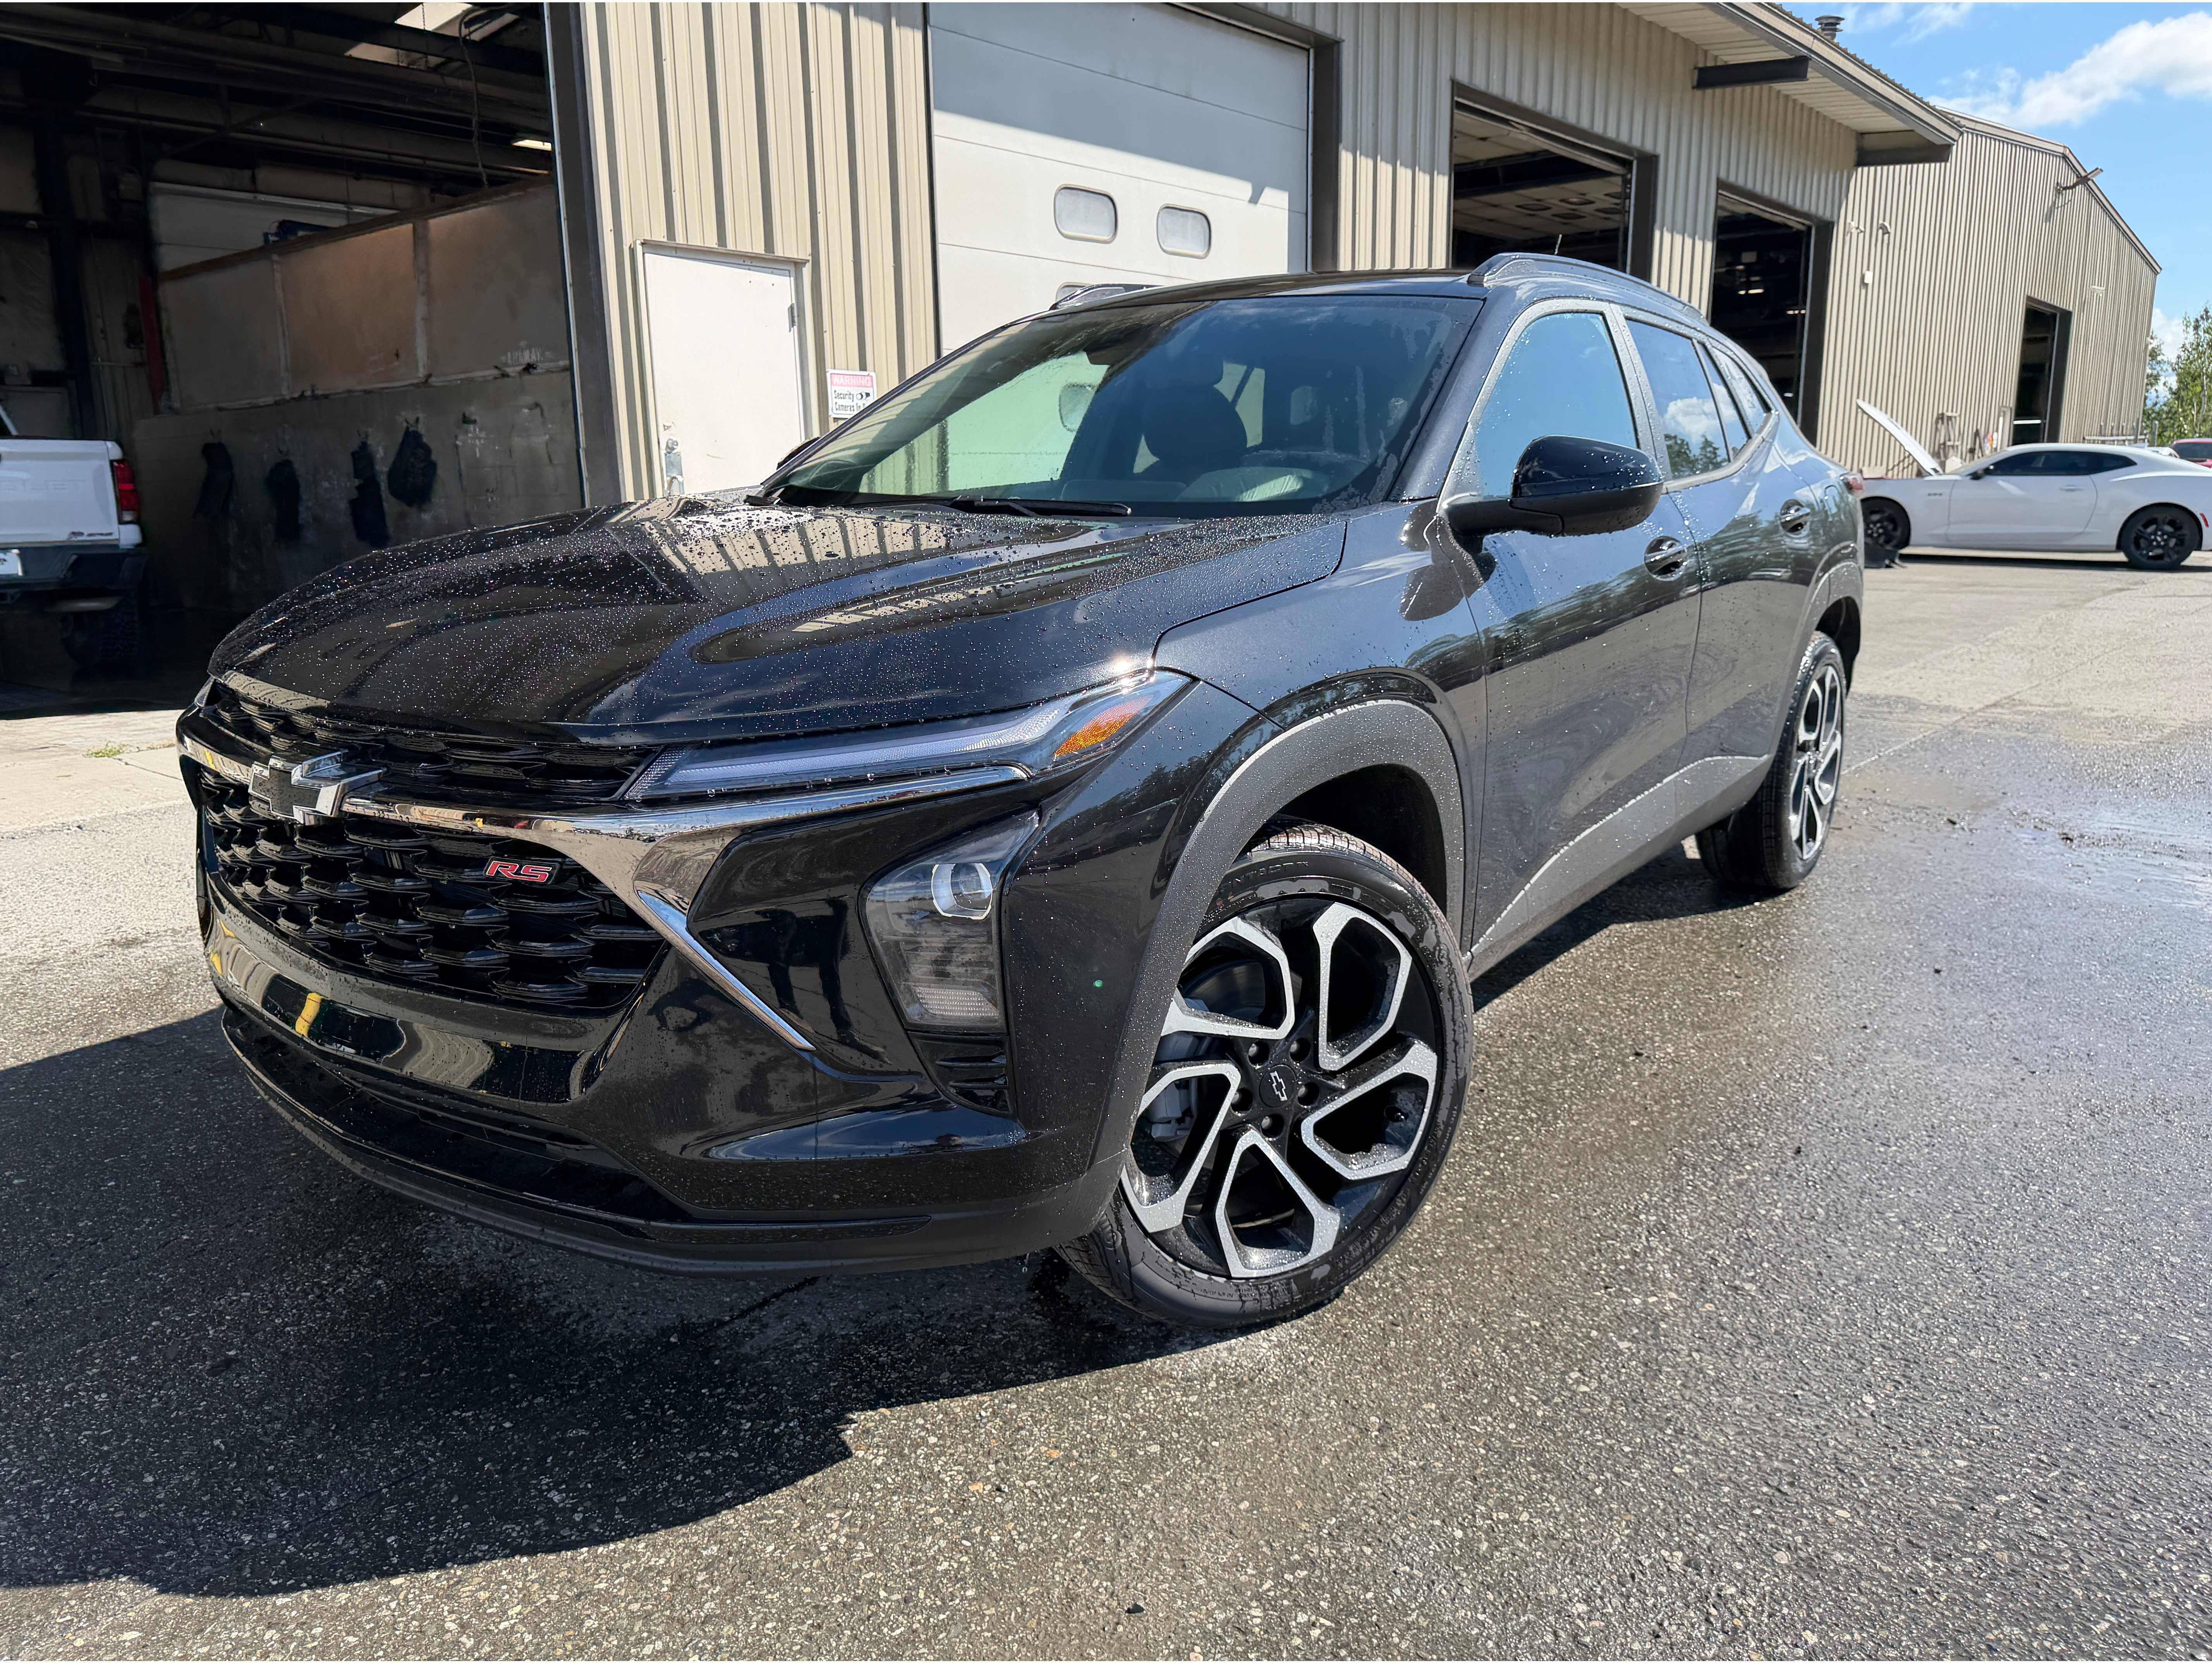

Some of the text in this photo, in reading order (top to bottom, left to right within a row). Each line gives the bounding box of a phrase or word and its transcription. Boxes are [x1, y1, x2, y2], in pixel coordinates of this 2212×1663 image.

[833, 375, 871, 387] WARNING
[834, 390, 854, 402] Security
[835, 402, 855, 412] Cameras
[486, 861, 552, 882] RS
